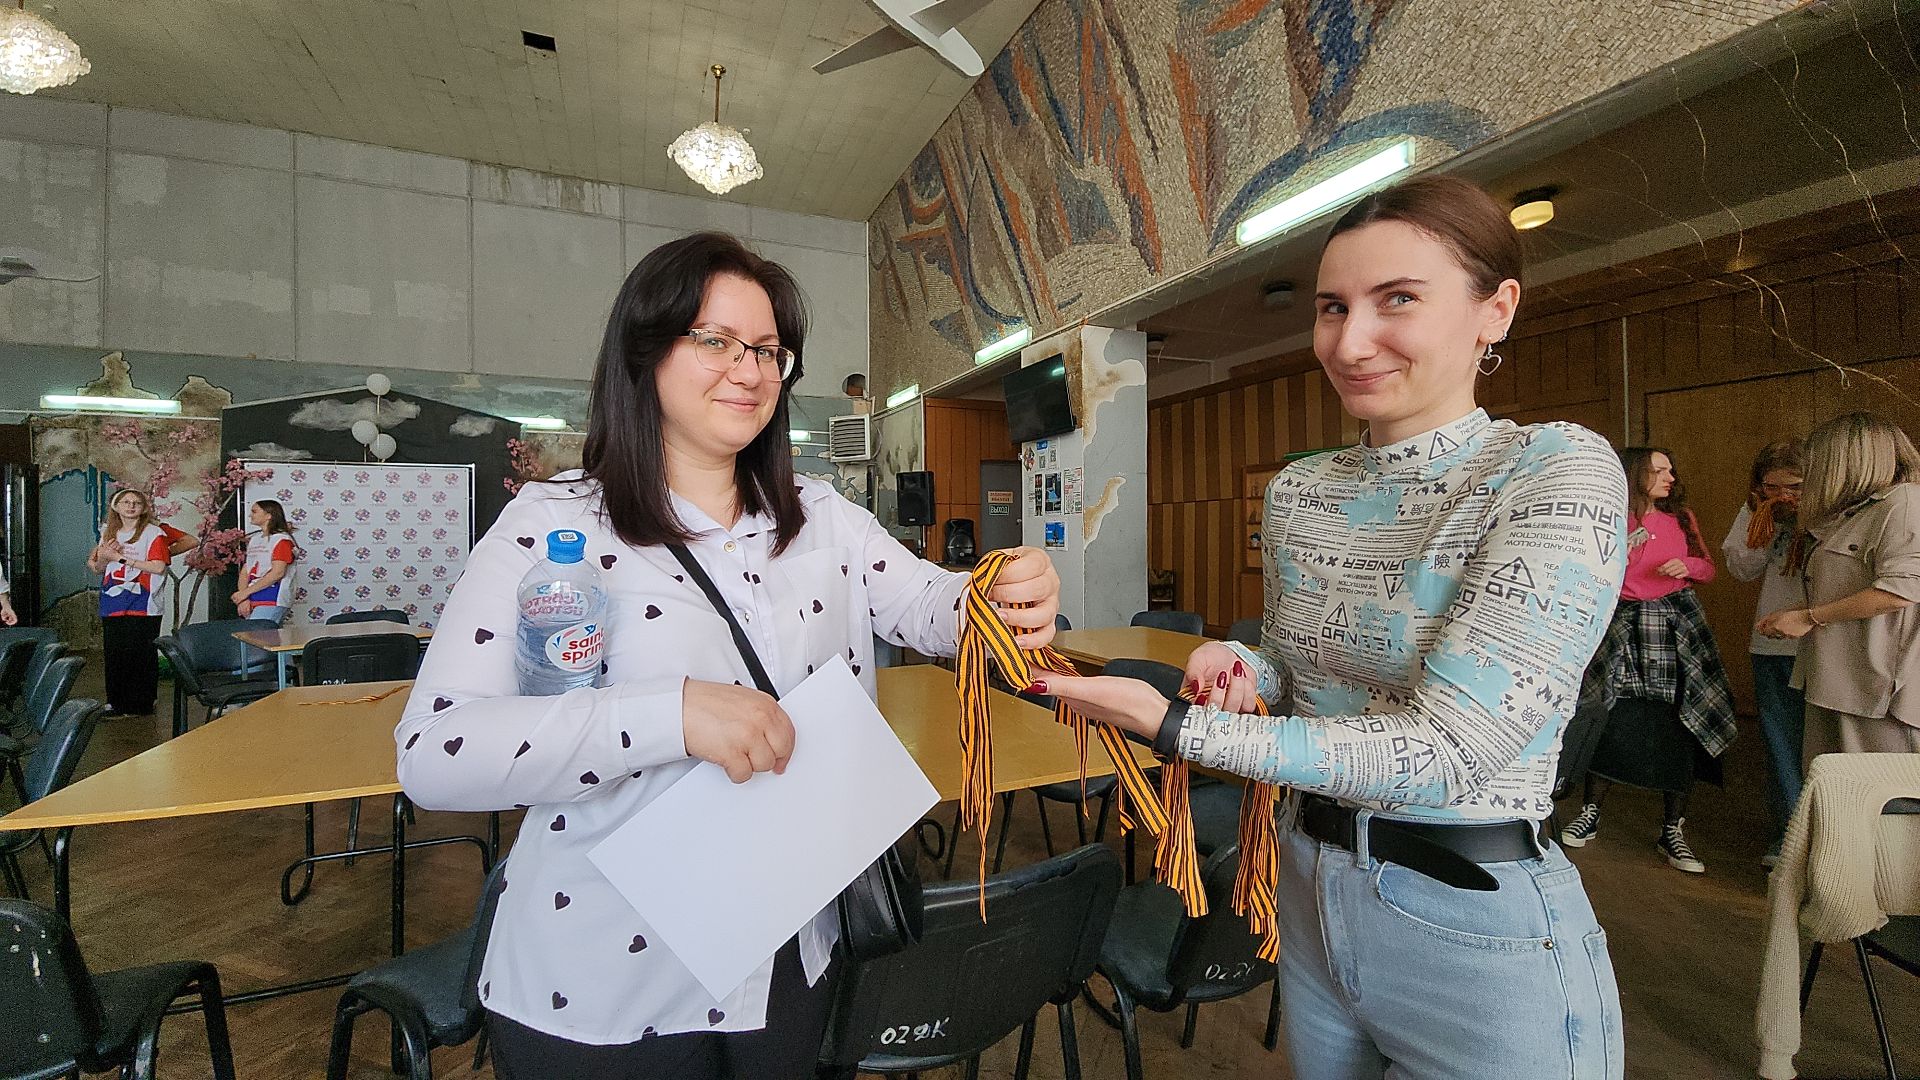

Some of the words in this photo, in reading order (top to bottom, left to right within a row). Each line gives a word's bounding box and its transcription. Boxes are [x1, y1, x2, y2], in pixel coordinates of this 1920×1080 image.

[1509, 531, 1568, 542] INSTRUCTION
[1504, 539, 1541, 547] FOLLOW
[1569, 537, 1584, 545] THE
[1543, 542, 1563, 550] AND
[1565, 546, 1586, 555] READ
[1483, 595, 1508, 607] CONTACT
